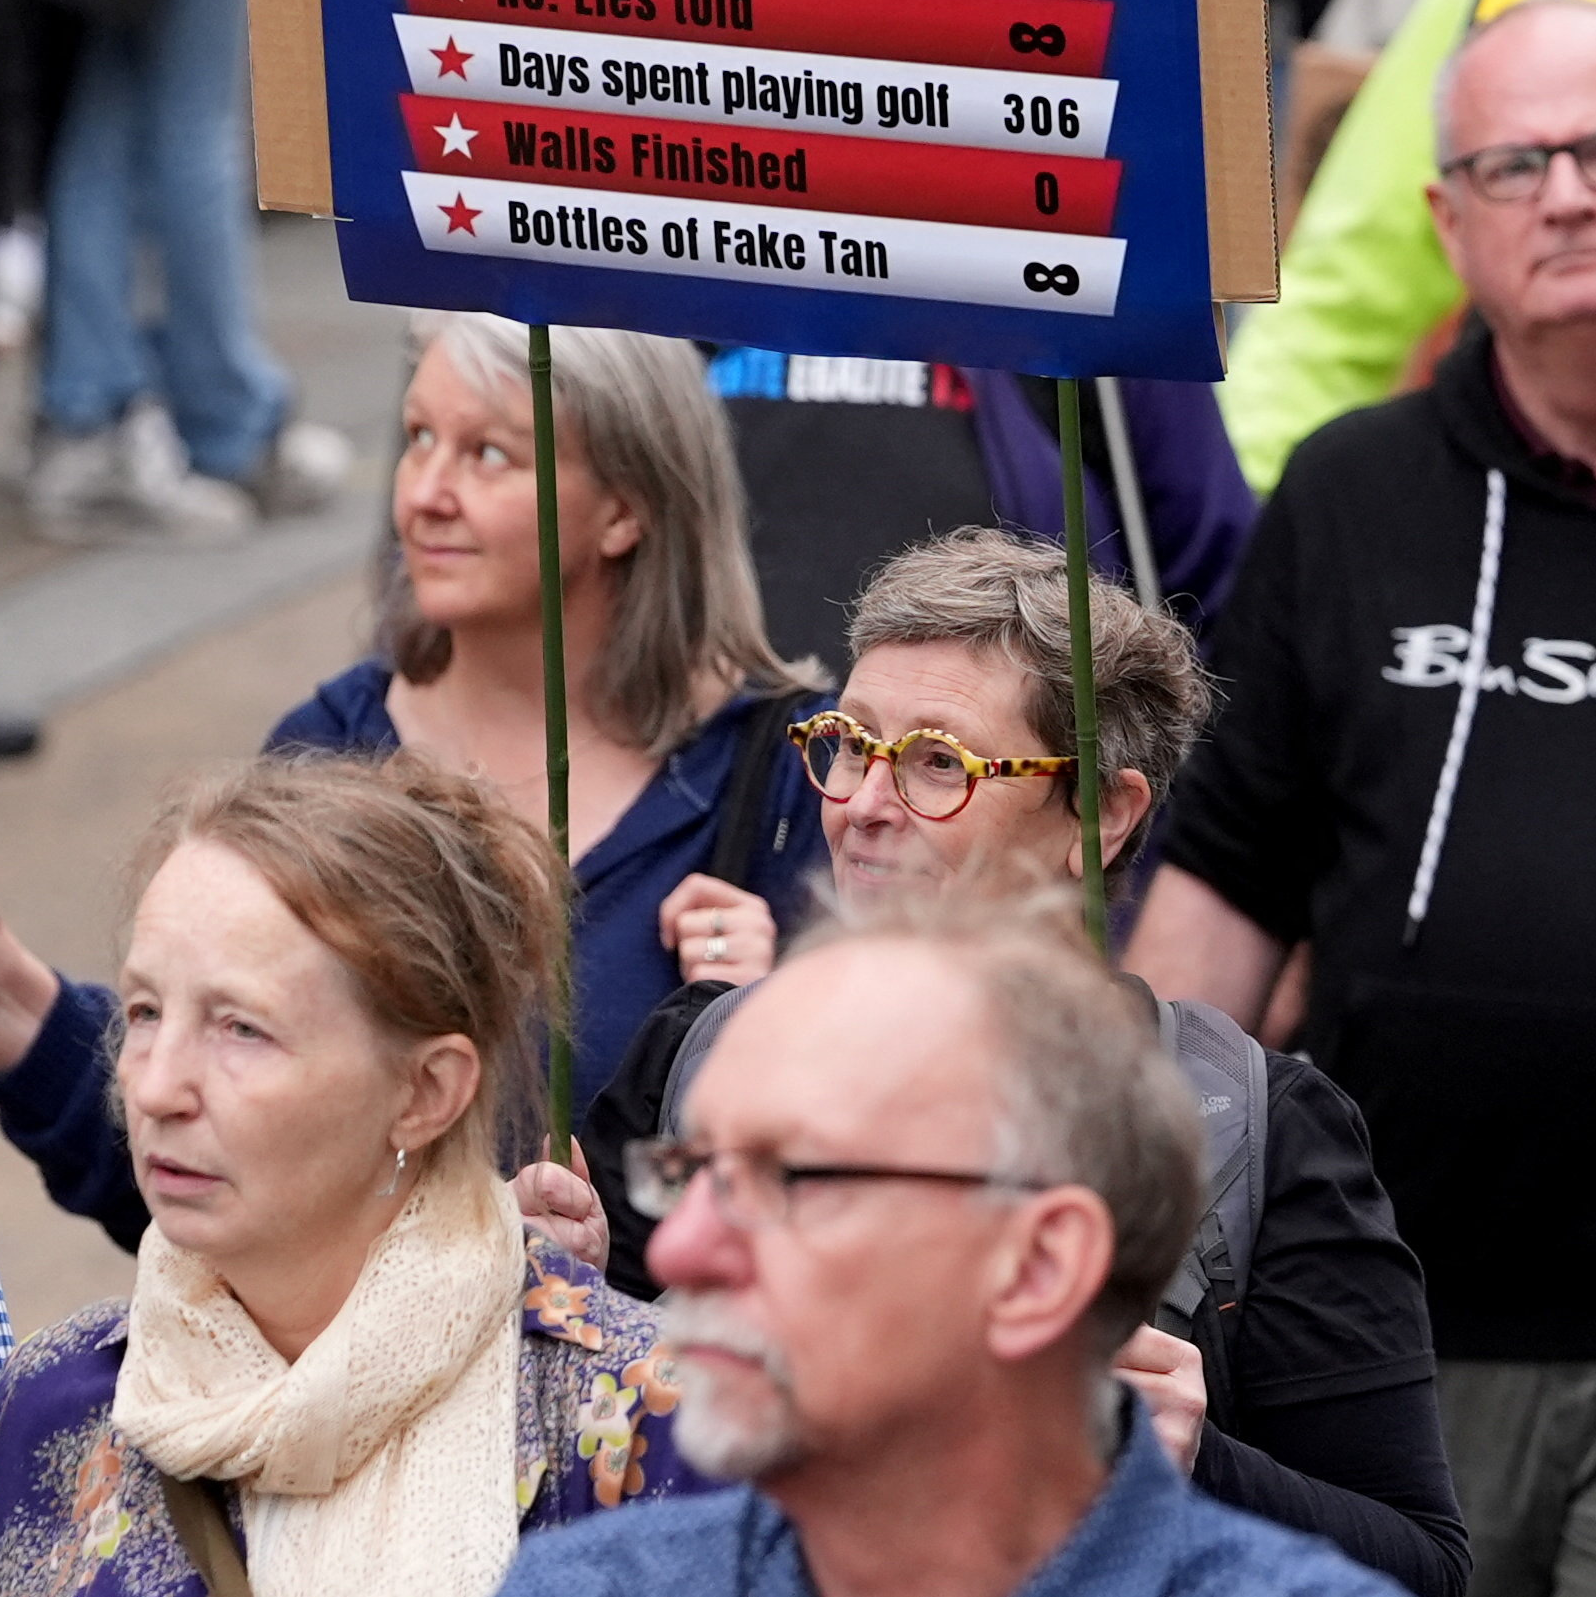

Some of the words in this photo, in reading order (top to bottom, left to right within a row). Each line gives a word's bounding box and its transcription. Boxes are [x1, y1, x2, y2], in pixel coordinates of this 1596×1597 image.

[499, 43, 590, 97] Days
[602, 60, 710, 106] spent
[722, 65, 864, 125] playing
[876, 82, 949, 129] golf
[1004, 92, 1080, 139] 306
[504, 121, 616, 174] Walls
[631, 132, 808, 193] Finished
[1034, 170, 1060, 216] 0
[508, 200, 649, 255] Bottles
[662, 217, 700, 261] of
[713, 220, 806, 270] Fake
[819, 230, 889, 279] Tan
